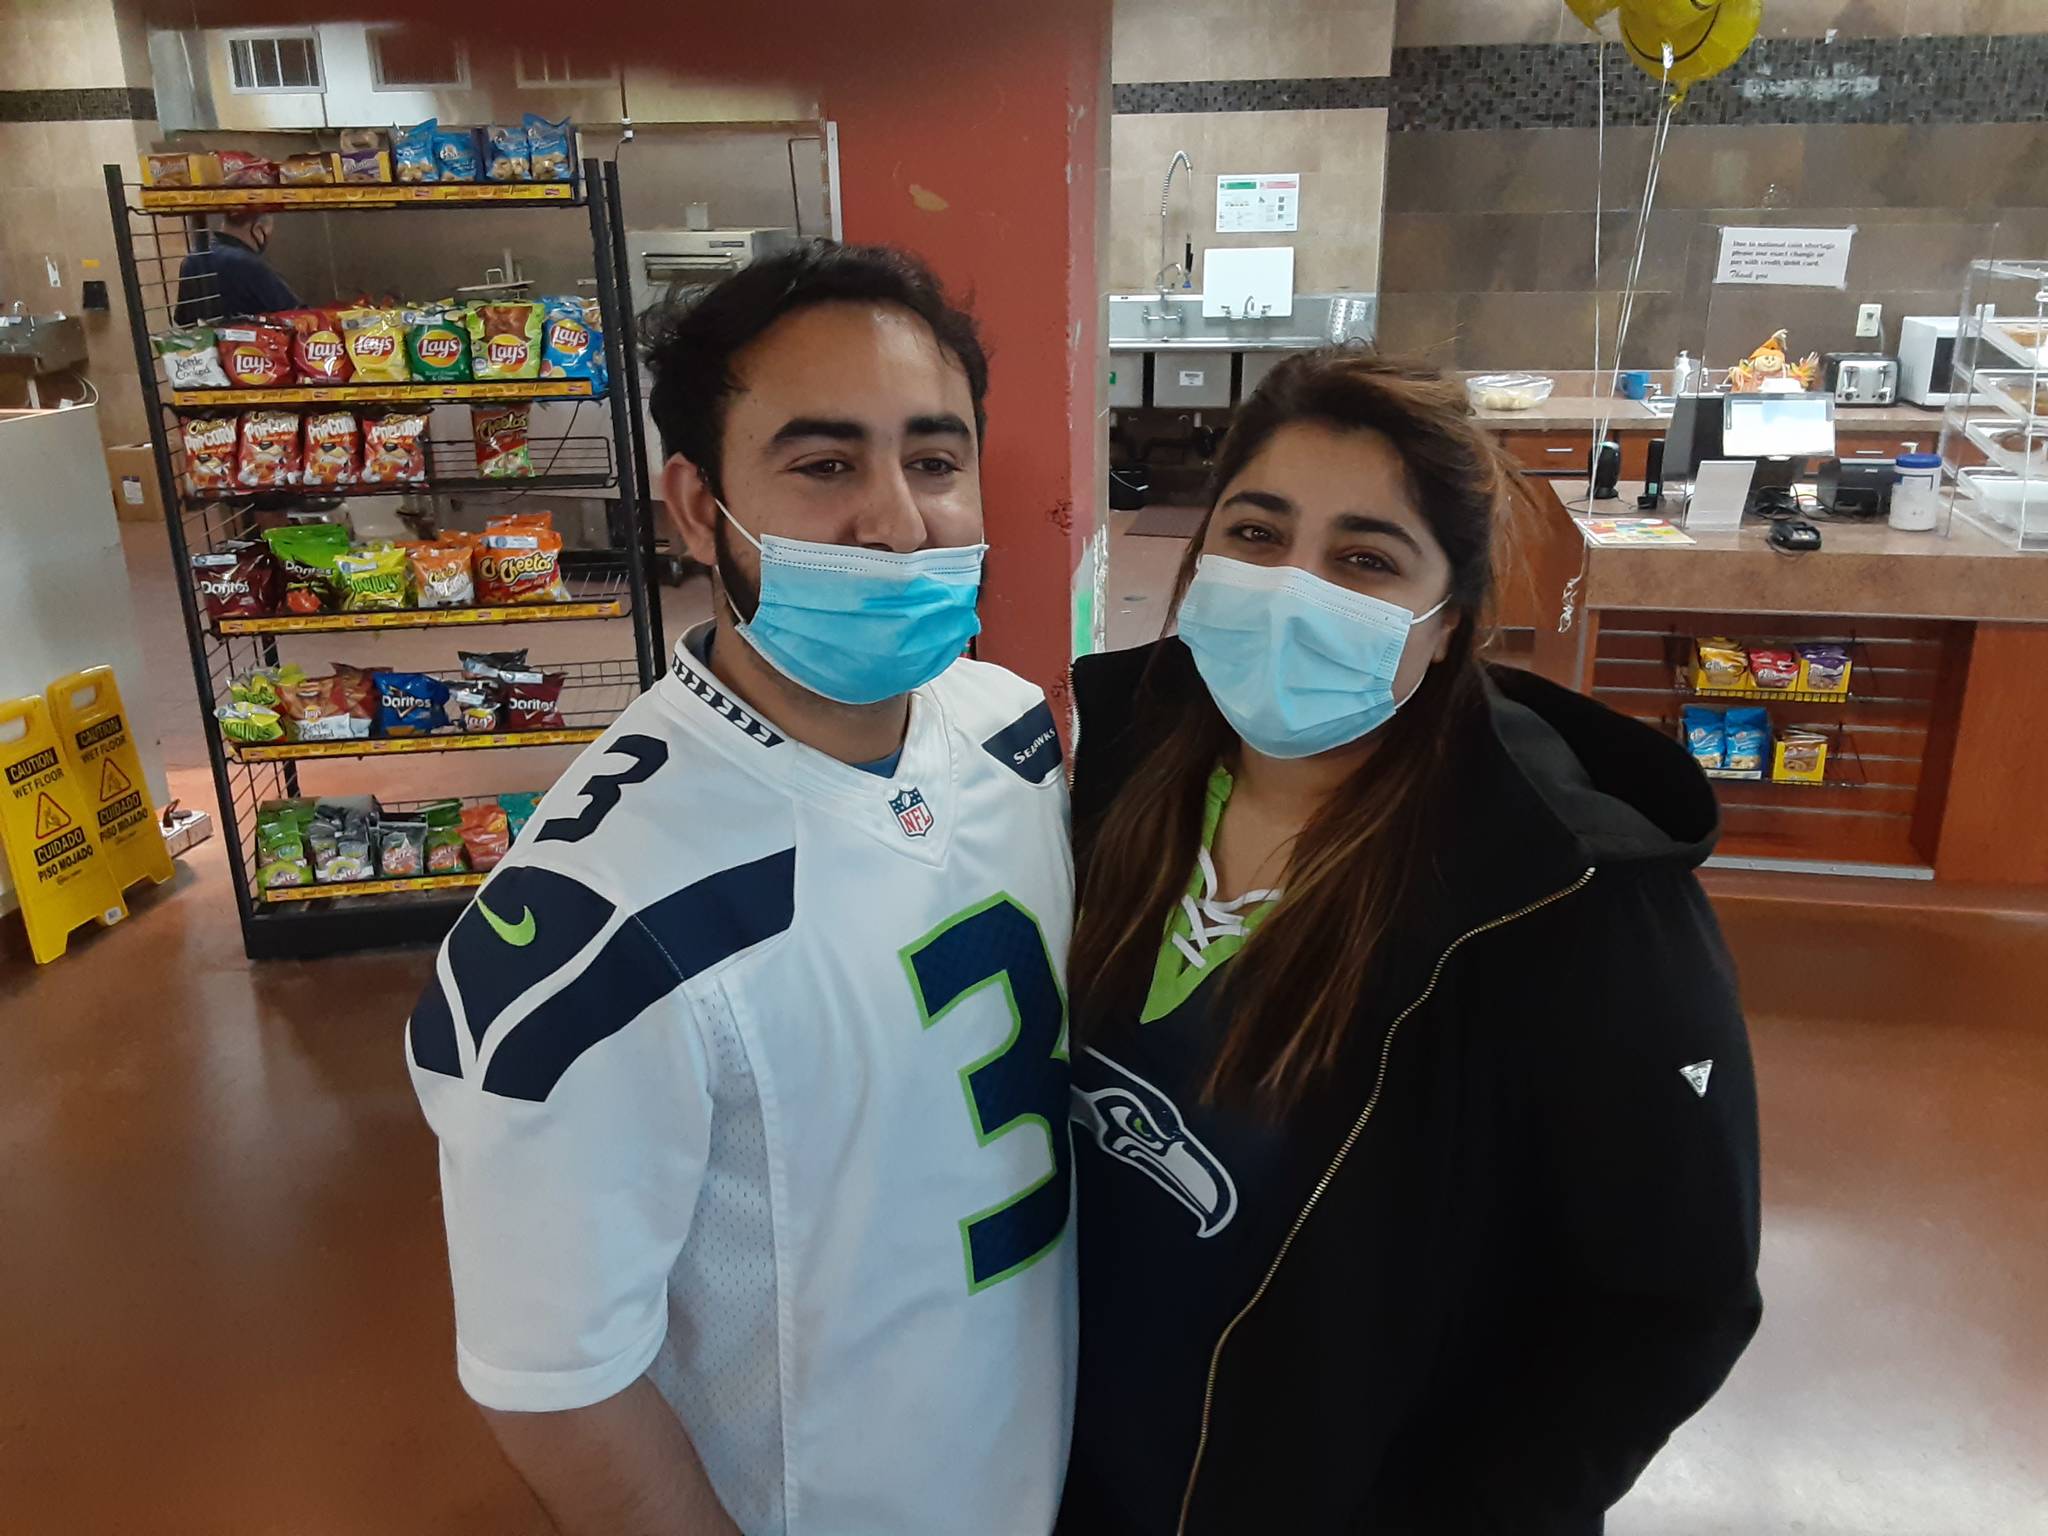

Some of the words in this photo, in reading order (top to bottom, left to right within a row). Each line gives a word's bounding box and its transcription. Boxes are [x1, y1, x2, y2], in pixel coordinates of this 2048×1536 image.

[477, 412, 527, 440] Cheetos
[501, 551, 553, 584] Cheetos
[200, 580, 250, 595] Doritos
[381, 696, 432, 708] Doritos
[510, 697, 558, 712] Doritos
[79, 717, 121, 746] CAUTION
[81, 749, 99, 763] WET
[100, 735, 126, 755] FLOOR
[10, 750, 55, 781] CAUTION
[13, 781, 33, 798] WET
[34, 767, 64, 788] FLOOR
[533, 733, 669, 844] 3
[100, 793, 140, 824] CUIDADO
[900, 806, 931, 833] NFL
[37, 829, 83, 862] CUIDADO
[38, 864, 58, 882] PISO
[59, 844, 93, 871] MOJADO
[897, 889, 1071, 1296] 3
